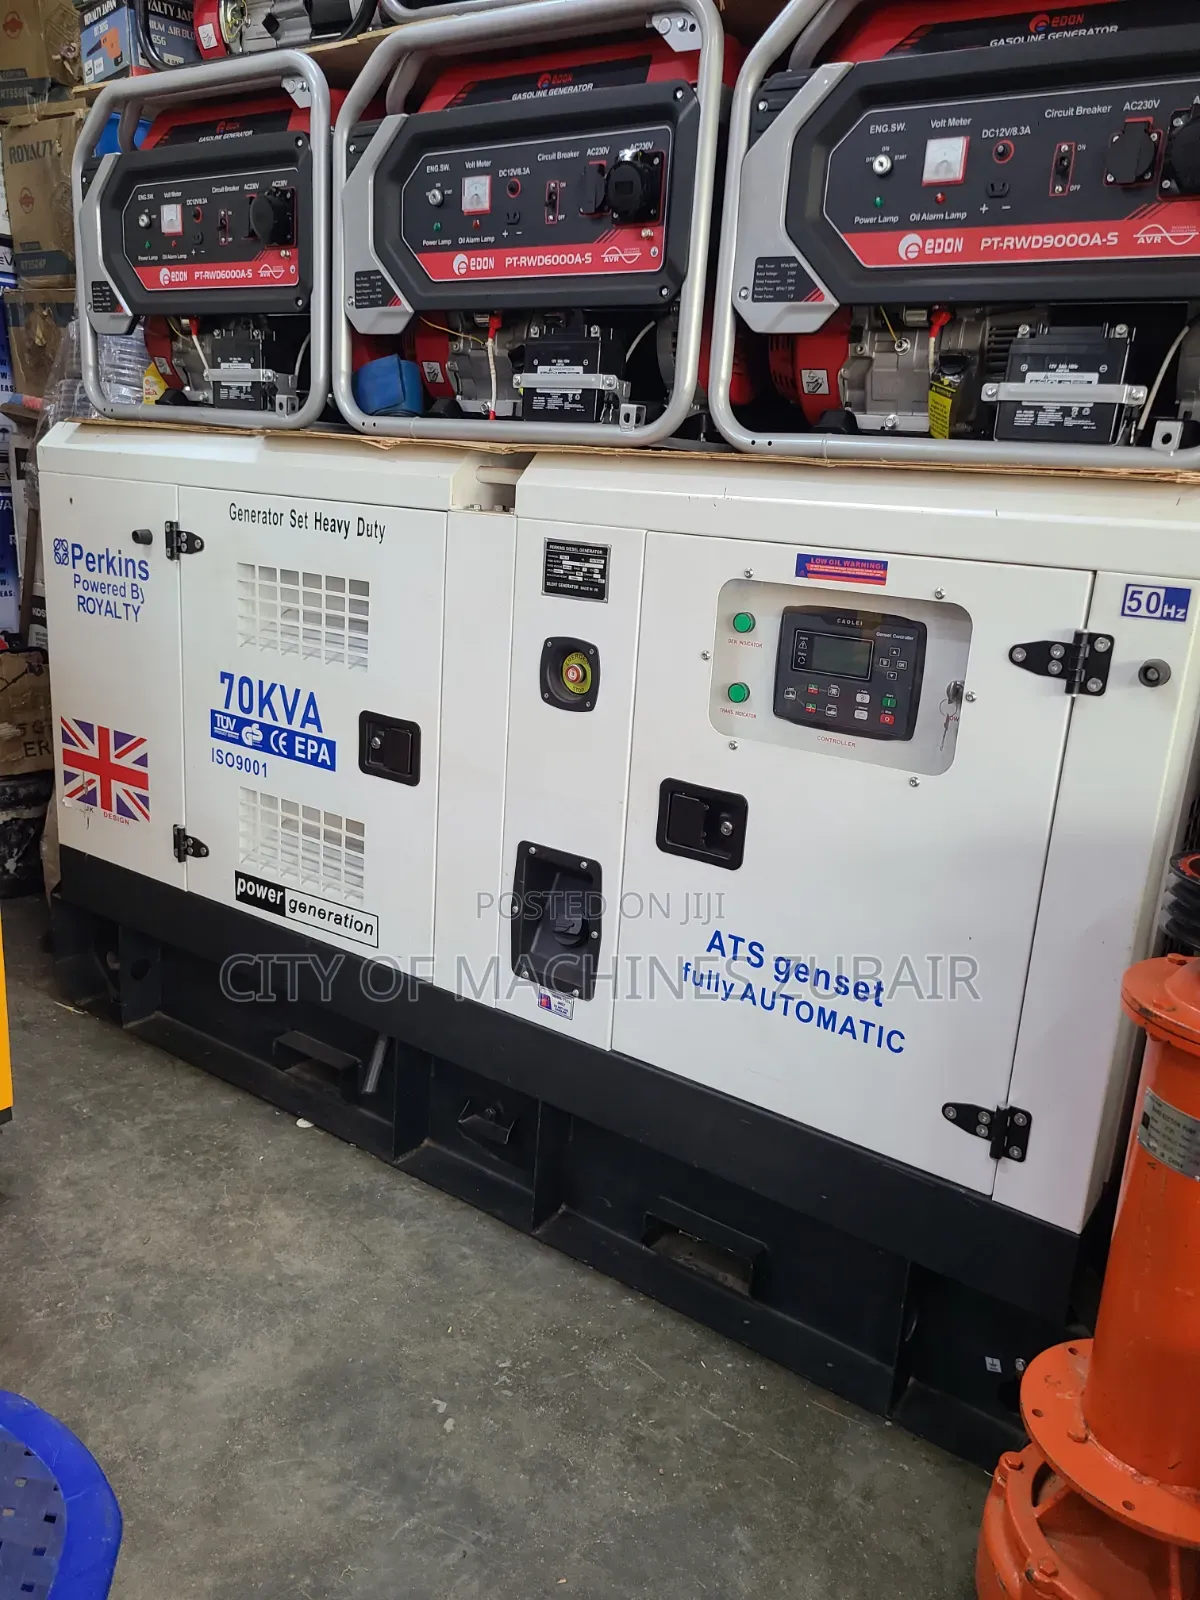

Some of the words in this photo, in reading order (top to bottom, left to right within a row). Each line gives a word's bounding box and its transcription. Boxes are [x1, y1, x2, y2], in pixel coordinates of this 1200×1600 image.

[989, 33, 1046, 48] GASOLINE
[1047, 24, 1119, 41] GENERATOR
[512, 89, 548, 101] GASOLINE
[548, 83, 594, 97] GENERATOR
[1044, 107, 1075, 118] Circuit
[1075, 103, 1112, 116] Breaker
[1123, 99, 1161, 112] AC230V
[930, 118, 946, 129] Volt
[947, 116, 972, 128] Meter
[981, 127, 1031, 139] DC12V/8.3A
[9, 139, 56, 165] ROYALTY
[537, 152, 556, 162] Circuit
[556, 150, 580, 160] Breaker
[586, 146, 610, 157] AC230V
[465, 160, 476, 169] Volt
[477, 159, 491, 168] Meter
[854, 215, 876, 225] Power
[878, 214, 899, 225] Lamp
[909, 211, 920, 222] Oil
[921, 211, 944, 221] Alarm
[945, 210, 967, 222] Lamp
[422, 238, 437, 247] Power
[437, 237, 452, 246] Lamp
[465, 236, 480, 244] Alarm
[480, 235, 495, 244] Lamp
[980, 232, 1119, 251] PT-RWD9000A-S
[1137, 236, 1162, 244] AVR
[505, 252, 592, 268] PT-RWD6000A-S
[228, 502, 284, 527] Generator
[289, 508, 309, 530] Set
[314, 511, 351, 540] Heavy
[356, 516, 386, 544] Duty
[71, 543, 150, 581] Perkins
[828, 558, 842, 567] OIL
[73, 573, 127, 598] Powered
[131, 583, 145, 605] By
[77, 595, 141, 623] ROYALTY
[220, 670, 323, 734] 70KVA
[816, 735, 857, 748] CONTROLLER
[294, 735, 332, 766] EPA
[211, 747, 268, 778] ISO9001
[103, 811, 130, 825] DESIGN
[236, 878, 284, 905] power
[288, 898, 374, 936] generation
[706, 929, 765, 969] ATS
[774, 955, 885, 1008] genset
[682, 961, 736, 1002] fully
[740, 981, 906, 1054] AUTOMATIC
